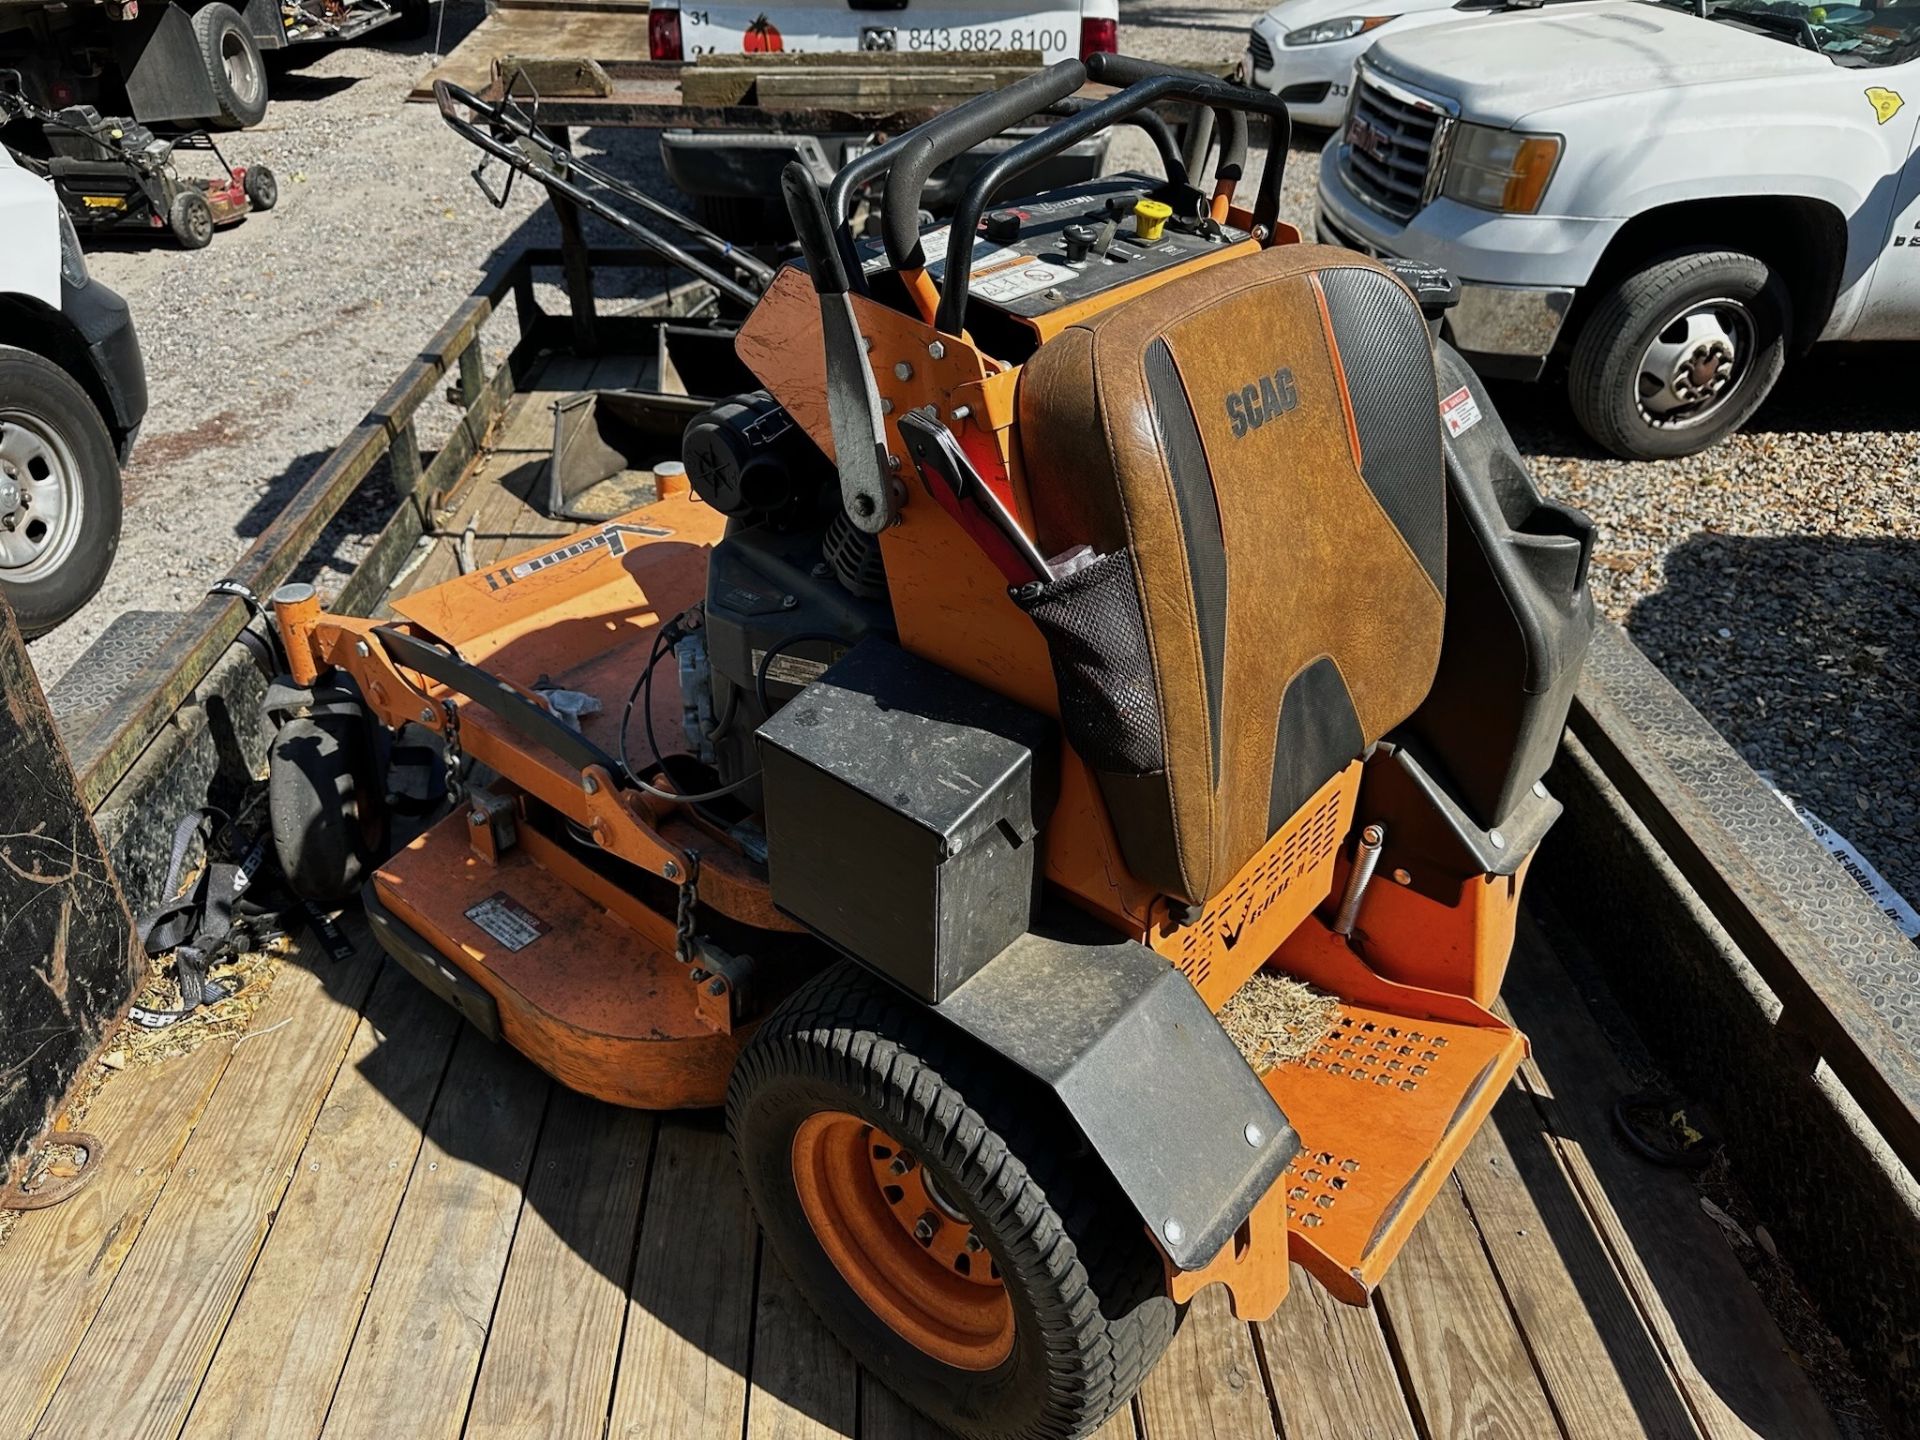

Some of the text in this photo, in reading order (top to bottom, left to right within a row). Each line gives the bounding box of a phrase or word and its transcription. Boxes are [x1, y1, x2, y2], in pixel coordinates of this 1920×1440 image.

[690, 11, 710, 26] 31
[908, 27, 1068, 52] 843.882.8100
[1331, 84, 1349, 97] 33
[1226, 367, 1298, 440] SCAG
